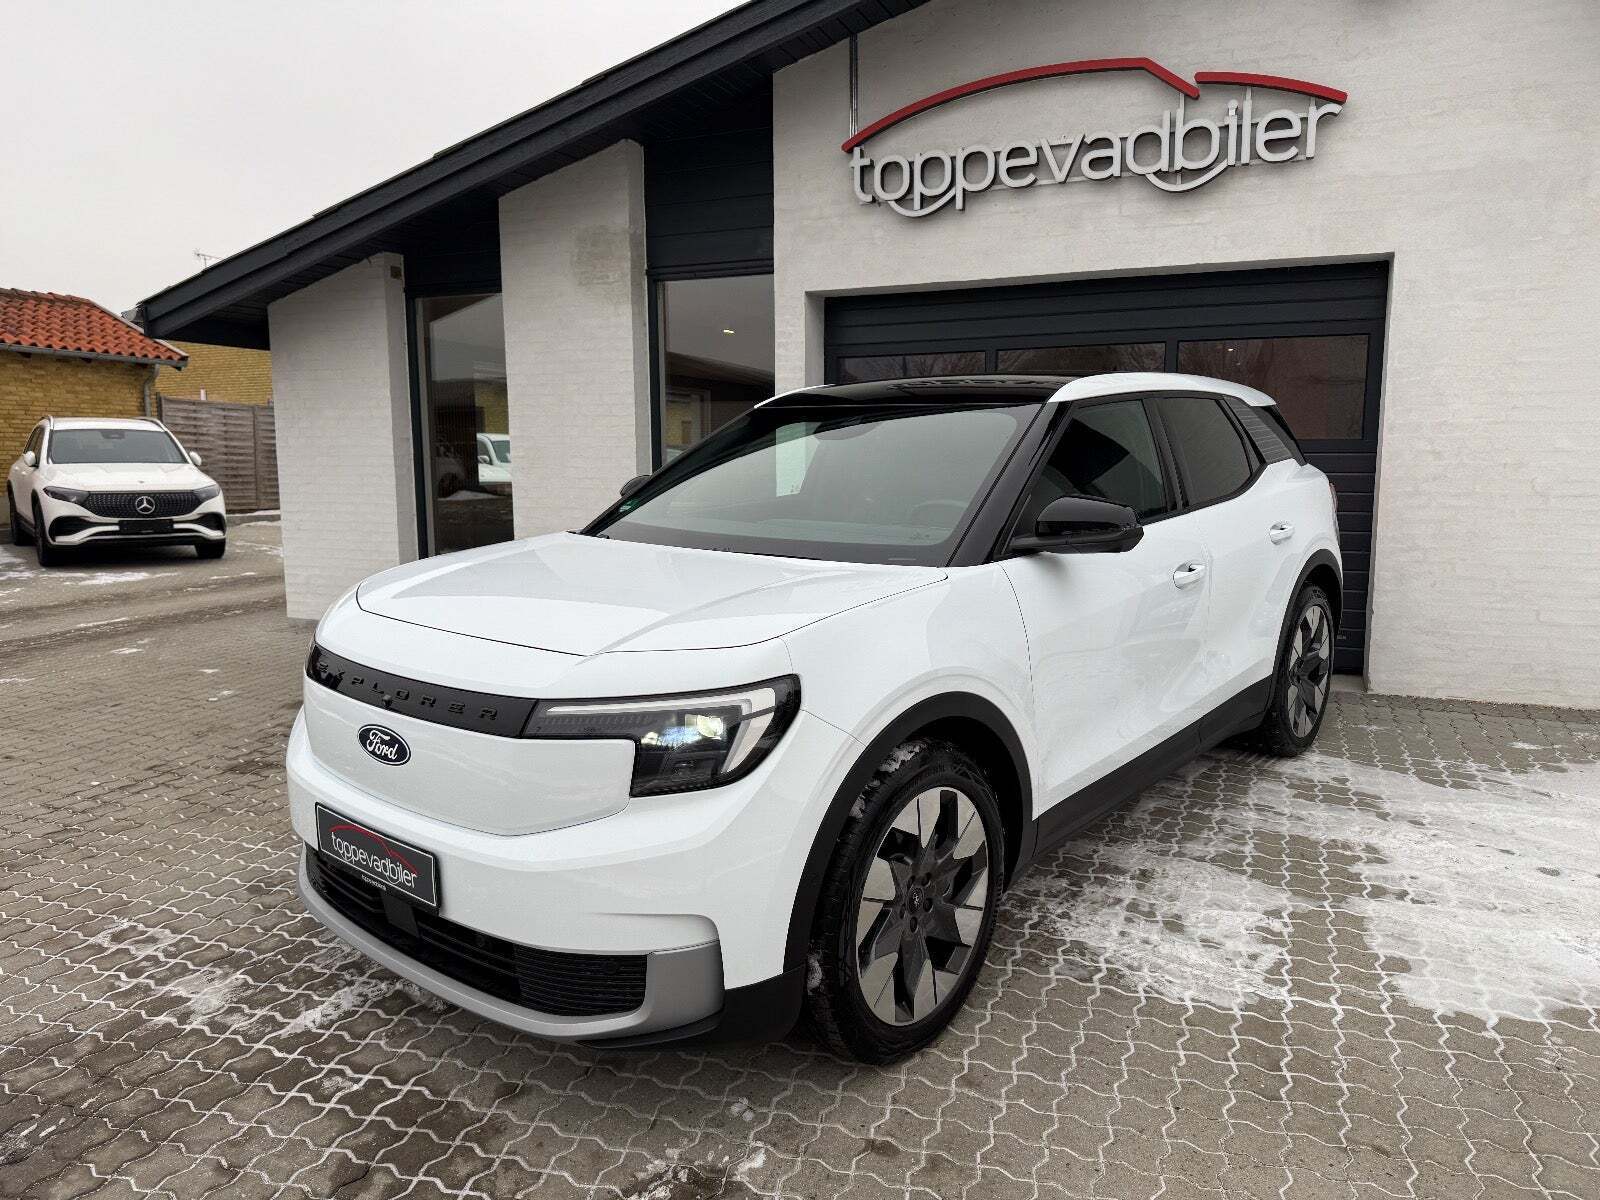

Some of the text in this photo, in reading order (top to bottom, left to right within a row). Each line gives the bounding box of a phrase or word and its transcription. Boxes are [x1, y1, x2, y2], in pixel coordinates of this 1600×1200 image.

[848, 99, 1343, 217] toppevadbiler
[319, 661, 498, 721] EXPLORER
[366, 729, 399, 760] Ford
[331, 832, 417, 888] toppevadbiler
